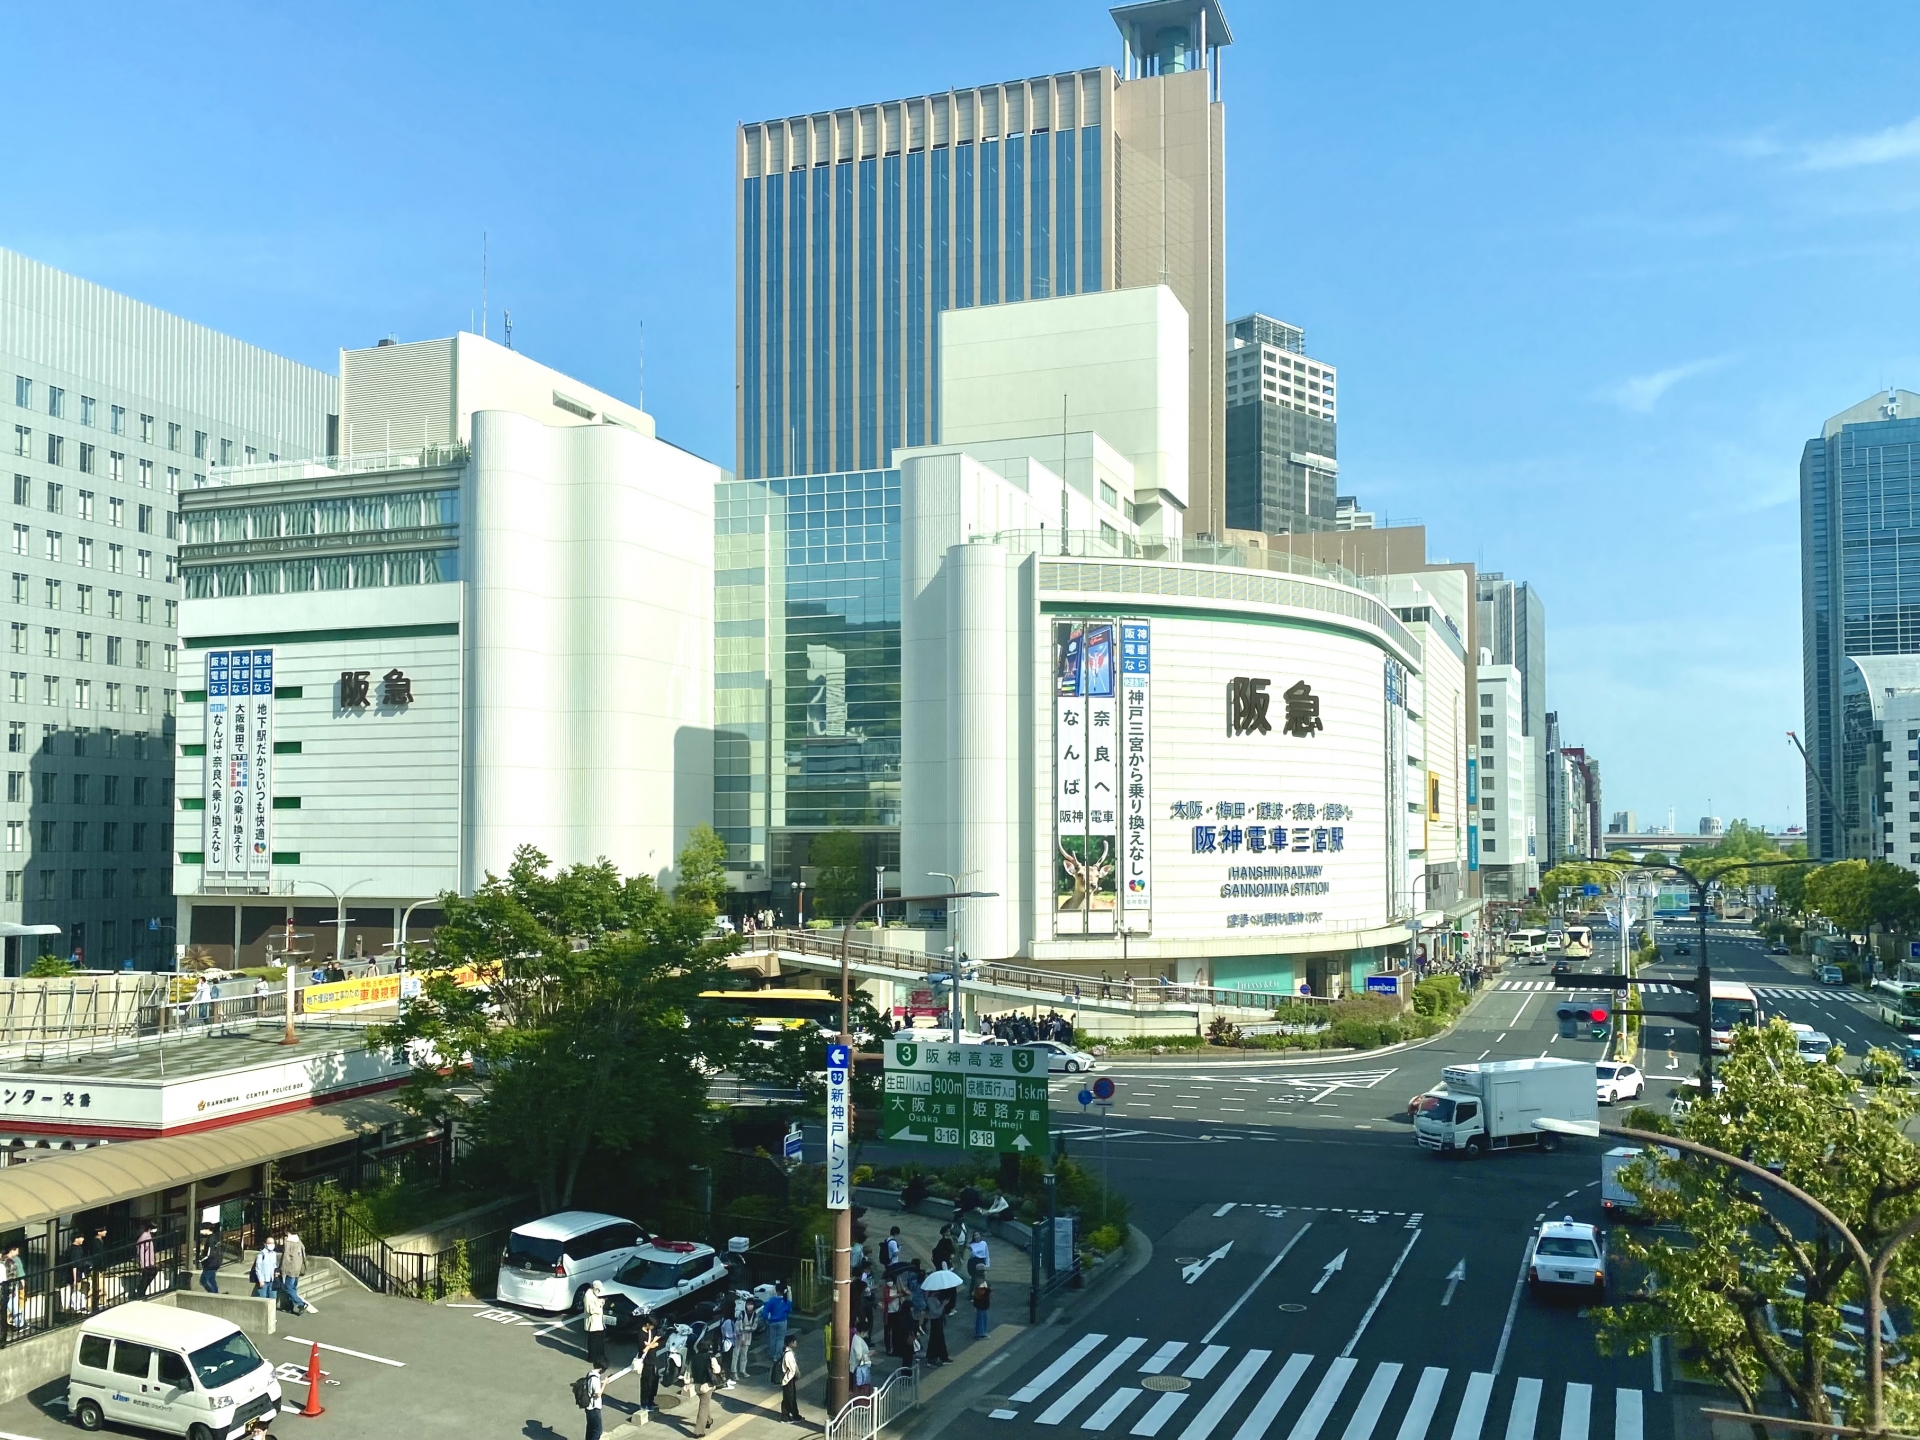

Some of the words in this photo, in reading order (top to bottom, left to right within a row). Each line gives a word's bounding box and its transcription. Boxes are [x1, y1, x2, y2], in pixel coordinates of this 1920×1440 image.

[1124, 628, 1147, 640] 阪神
[1124, 644, 1147, 655] 電車
[210, 656, 228, 667] 阪神
[232, 656, 249, 666] 阪神
[254, 655, 271, 665] 阪神
[1124, 660, 1147, 671] なら
[210, 670, 227, 680] 電車
[232, 669, 249, 680] 電車
[210, 684, 227, 694] なら
[232, 684, 249, 694] なら
[253, 683, 271, 693] なら
[341, 668, 414, 707] 阪急
[1232, 677, 1323, 734] 阪急
[235, 704, 246, 752] 大阪梅田で
[1063, 709, 1080, 795] なんば
[1094, 710, 1110, 793] 奈良へ
[254, 703, 267, 841] 地下駅だからいつも快適
[211, 714, 224, 863] なんば・奈良へ乗り換えなし
[1128, 690, 1145, 876] 神戸三宮から乗り換えなし
[1060, 809, 1084, 823] 阪神
[1090, 809, 1114, 823] 電車
[233, 789, 244, 864] への乗り換えすぐ
[1194, 825, 1344, 854] 阪神電車三宮駅
[1228, 866, 1281, 880] HANSHIN
[1283, 865, 1324, 879] RAILWAY
[1221, 883, 1289, 898] SANNOMIYA
[1291, 882, 1330, 896] STATION
[925, 1049, 1004, 1068] 阪神高速
[886, 1076, 931, 1093] 生田川入口
[934, 1077, 962, 1095] 900m
[967, 1080, 1015, 1098] 京橋西行入口
[206, 1095, 239, 1108] SANNOMIYA
[245, 1090, 269, 1100] CENTER
[272, 1084, 292, 1094] POLICE
[292, 1082, 304, 1090] BOX
[891, 1096, 956, 1115] 大阪方面
[972, 1101, 1040, 1121] 姫路方面
[908, 1113, 939, 1124] Osaka
[990, 1119, 1022, 1131] Himeji
[935, 1129, 958, 1143] 3-16
[971, 1131, 993, 1146] 3-18
[830, 1087, 845, 1205] 新神戸トンネル
